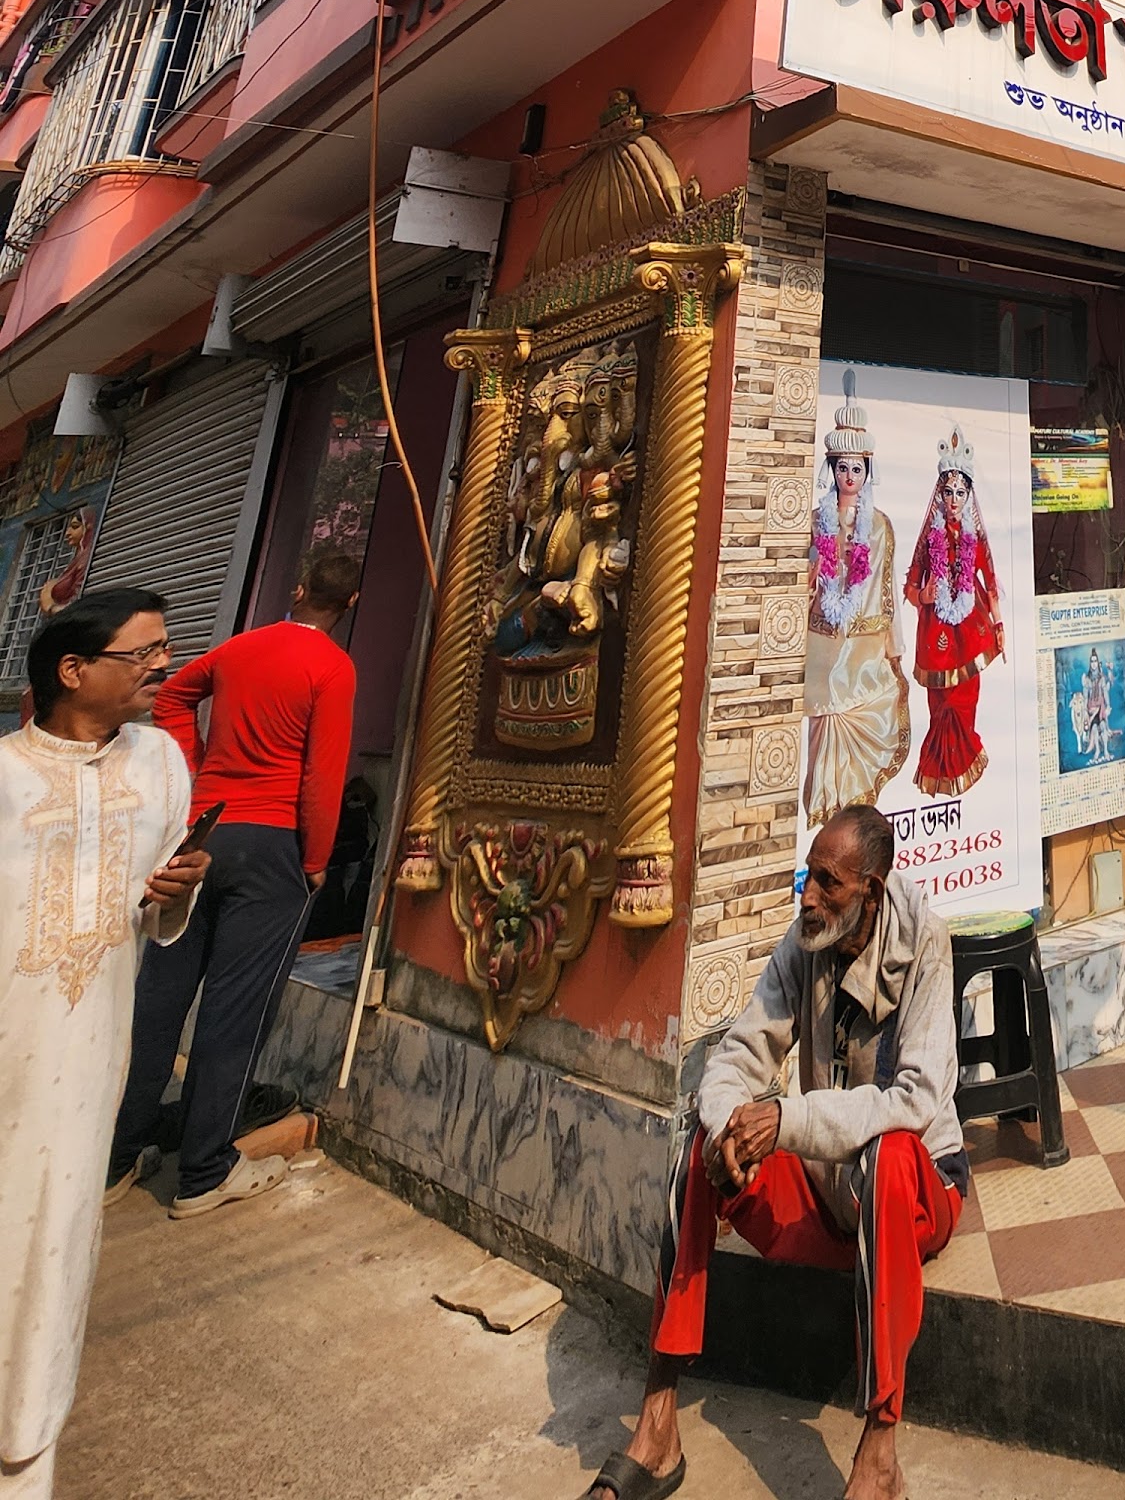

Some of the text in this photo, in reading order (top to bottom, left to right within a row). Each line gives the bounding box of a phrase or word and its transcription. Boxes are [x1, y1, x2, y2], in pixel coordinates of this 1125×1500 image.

[1003, 80, 1048, 110] শুভ
[1050, 605, 1108, 621] GUPTA ENTERPRISE
[920, 799, 962, 836] ভবন
[893, 829, 1002, 871] 8823468
[915, 860, 1003, 897] 716038
